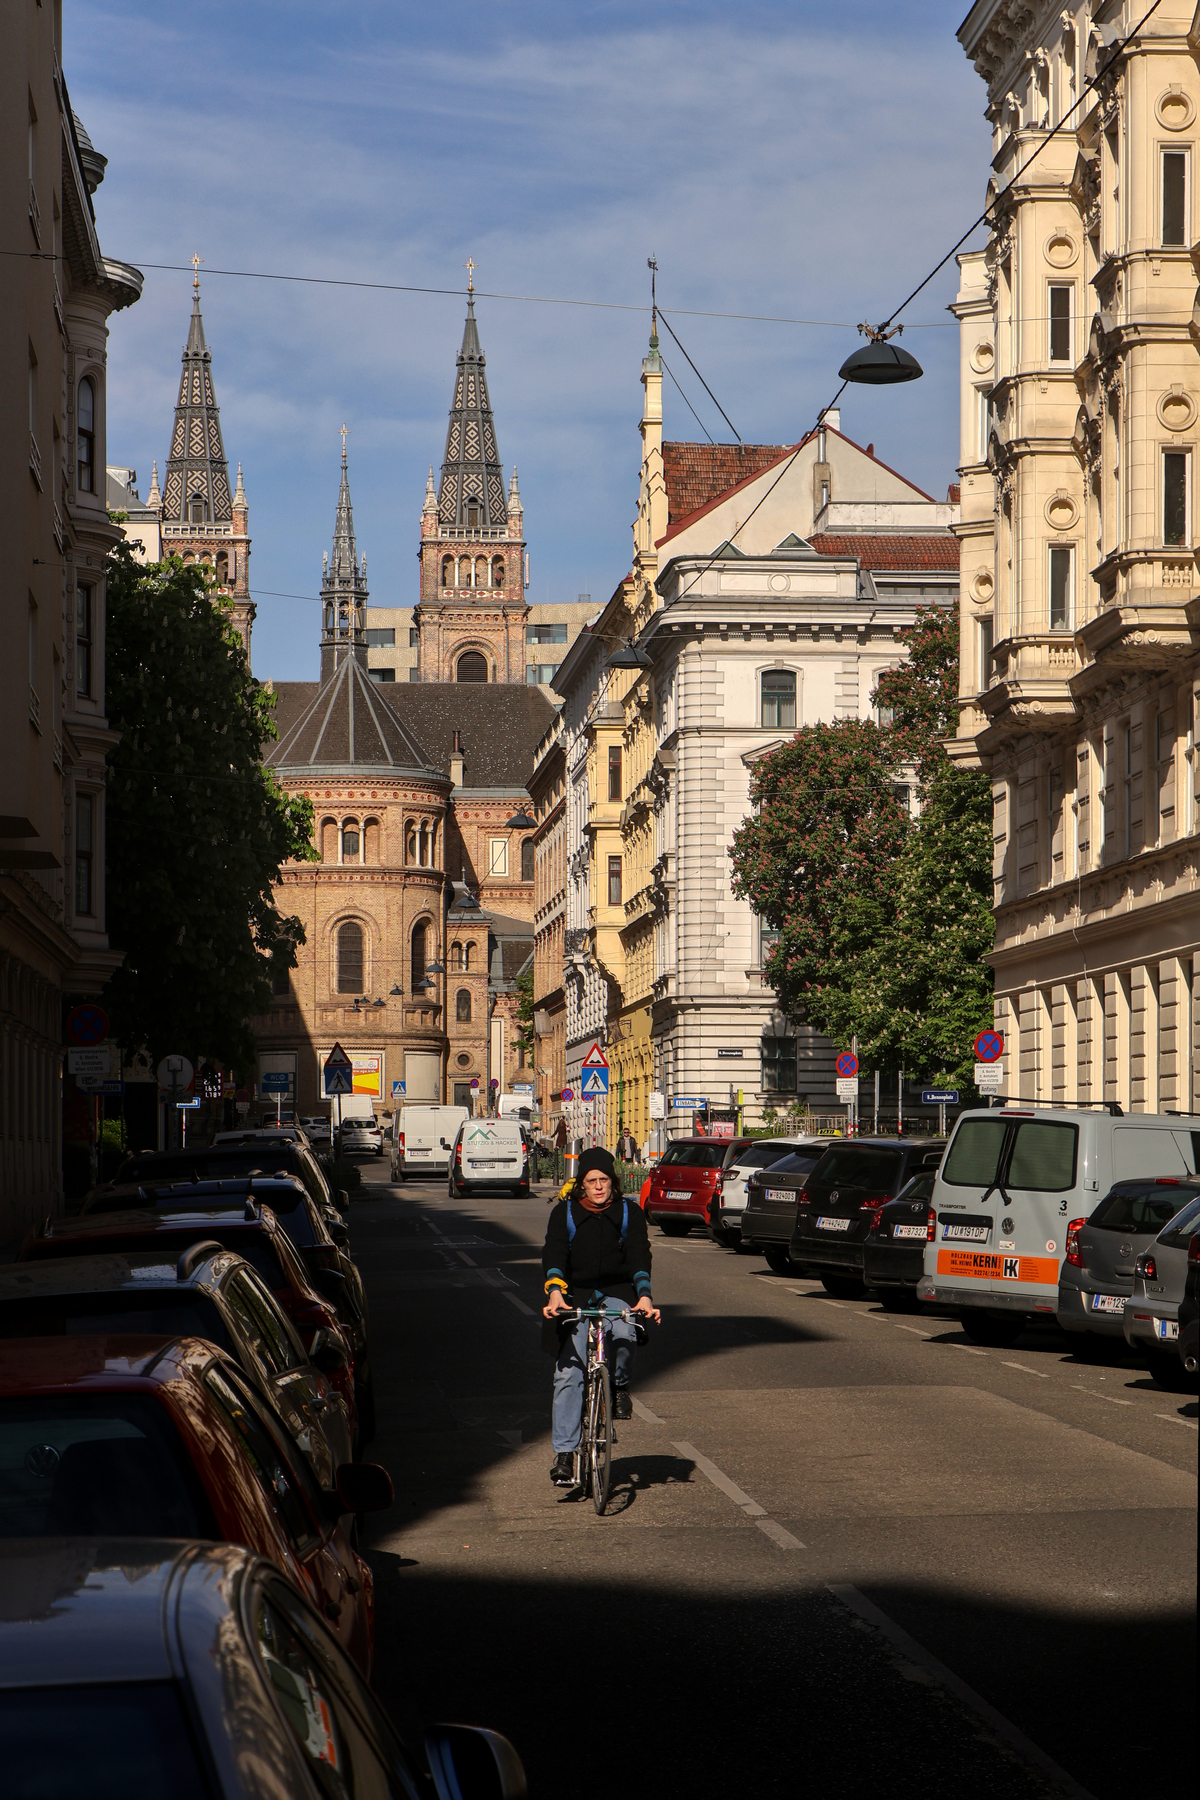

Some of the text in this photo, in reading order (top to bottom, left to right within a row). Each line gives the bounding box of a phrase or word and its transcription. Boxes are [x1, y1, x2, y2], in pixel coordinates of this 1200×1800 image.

[981, 1086, 997, 1094] Anfang
[1059, 1200, 1068, 1211] 3
[951, 1252, 973, 1260] HOLZBAU
[973, 1254, 998, 1269] KERN
[1004, 1258, 1019, 1278] HK
[1171, 1324, 1178, 1336] W
